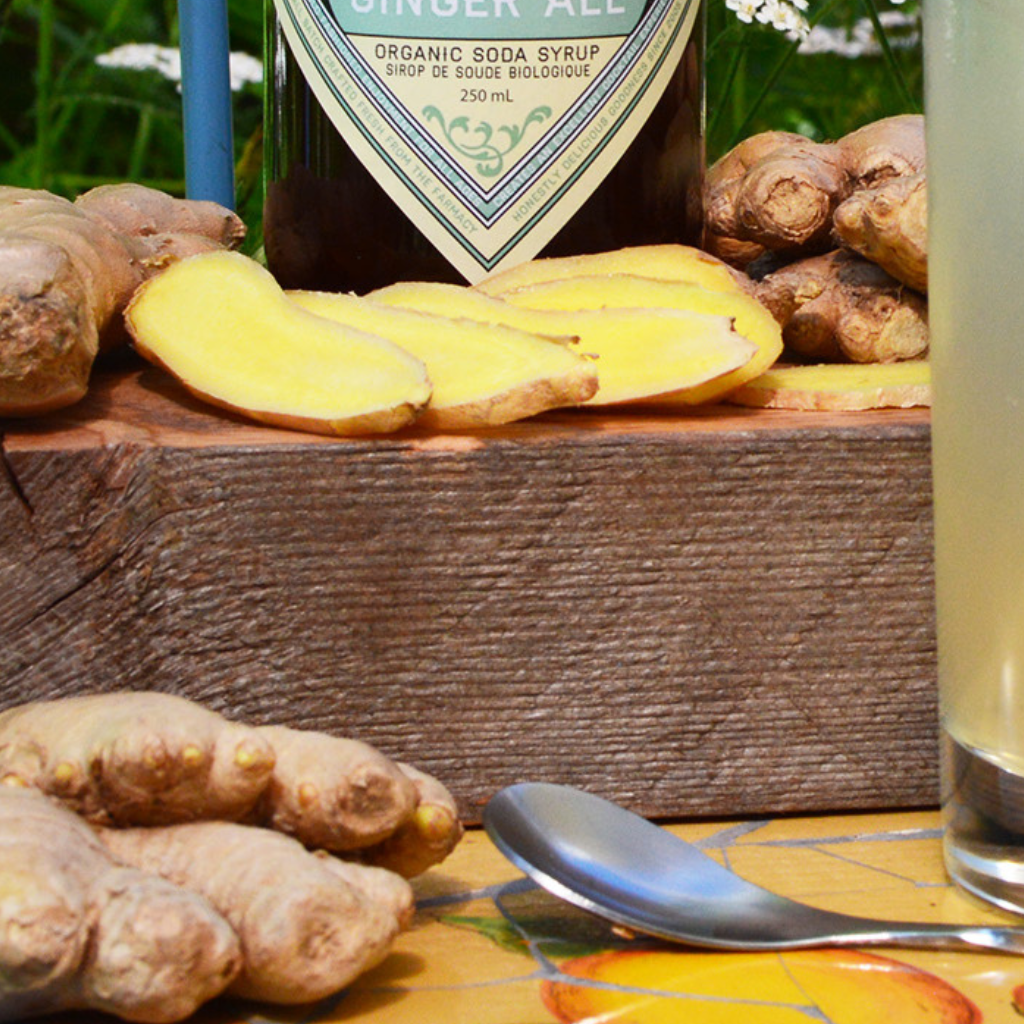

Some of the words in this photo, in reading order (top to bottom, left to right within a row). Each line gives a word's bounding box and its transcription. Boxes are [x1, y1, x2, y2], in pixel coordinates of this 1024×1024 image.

[375, 43, 463, 63] ORGANIC
[472, 47, 528, 63] SODA
[537, 44, 601, 62] SYRUP
[385, 63, 426, 78] SIROP
[432, 65, 449, 78] DE
[455, 66, 502, 79] SOUDE
[509, 64, 591, 79] BIOLOGIQUE
[301, 17, 325, 53] BATCH
[322, 54, 358, 101] CRAFTED
[355, 100, 386, 135] FRESH
[383, 135, 413, 166] FROM
[410, 164, 432, 186] THE
[430, 185, 478, 235] FARMACY
[460, 88, 487, 103] 250
[491, 88, 514, 102] mL
[492, 162, 537, 208] CREATES
[535, 145, 553, 163] AN
[551, 90, 602, 147] EXCELLENT
[600, 39, 641, 90] COCKTAIL
[511, 169, 563, 222] HONESTLY
[561, 116, 609, 170] DELICIOUS
[606, 61, 648, 116] GOODNESS
[645, 28, 668, 61] SINCE
[413, 135, 434, 157] FOR
[433, 157, 455, 179] ALL
[453, 178, 483, 207] AGES
